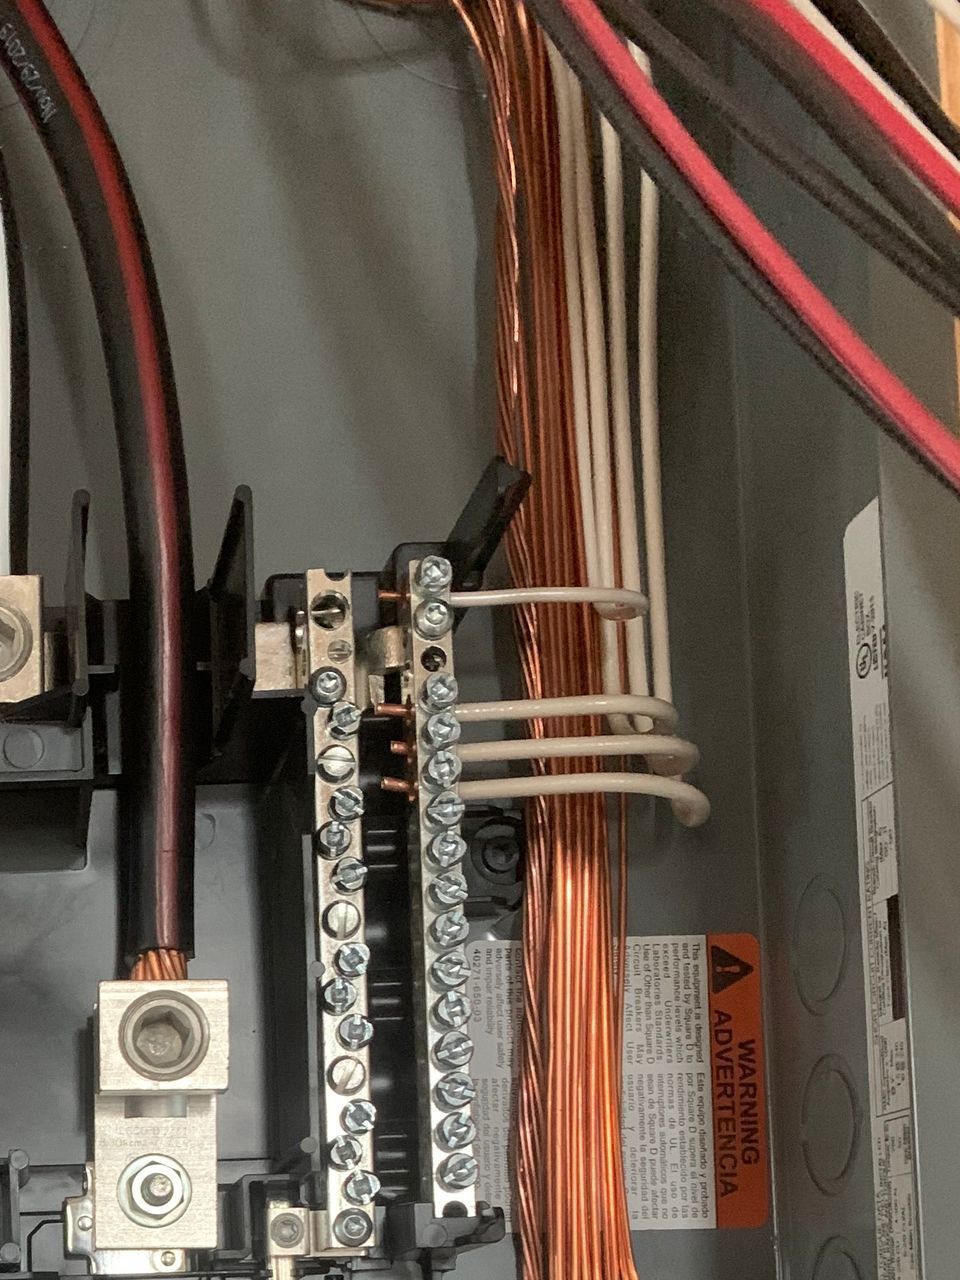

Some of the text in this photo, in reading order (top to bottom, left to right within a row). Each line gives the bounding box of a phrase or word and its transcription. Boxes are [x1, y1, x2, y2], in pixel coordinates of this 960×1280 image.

[504, 948, 512, 971] parts
[643, 944, 651, 960] Use
[485, 968, 494, 994] impair
[495, 948, 503, 991] adversely
[506, 975, 513, 984] of
[644, 964, 652, 972] of
[653, 944, 661, 1005] Laboratories
[672, 943, 681, 1001] performance
[683, 963, 691, 989] tested
[472, 949, 481, 1023] 40271-650-03
[644, 975, 653, 999] Other
[683, 994, 692, 1004] by
[485, 997, 495, 1035] reliability
[625, 1003, 633, 1032] Affect
[633, 944, 644, 1064] Circuit Breakers May
[645, 1001, 653, 1020] than
[663, 944, 673, 1064] exceed Underwriters
[692, 943, 704, 1063] This equipment is designed
[504, 1009, 513, 1044] product
[645, 1023, 653, 1054] Square
[683, 1008, 692, 1039] Square
[496, 1043, 505, 1069] safety
[626, 1042, 634, 1065] User
[686, 1055, 693, 1063] to
[667, 1073, 675, 1109] normas
[685, 1072, 693, 1087] por
[697, 1072, 705, 1092] Este
[636, 1074, 646, 1141] negativamente
[648, 1098, 656, 1109] de
[687, 1090, 696, 1122] Square
[697, 1096, 705, 1126] equipo
[713, 1009, 738, 1198] ADVERTENCIA
[737, 1039, 760, 1165] WARNING
[648, 1113, 657, 1144] Square
[669, 1117, 677, 1130] de
[688, 1126, 696, 1134] D
[483, 1140, 492, 1172] usuario
[640, 1144, 648, 1152] la
[656, 1073, 669, 1219] interruptores automáticos que no
[677, 1073, 690, 1219] rendimiento establecido por las
[688, 1137, 696, 1168] supera
[699, 1129, 707, 1169] diseñado
[492, 1127, 501, 1199] negativamente
[630, 1147, 639, 1196] deteriorar
[649, 1159, 658, 1186] puede
[670, 1163, 677, 1173] El
[690, 1171, 697, 1179] el
[639, 1157, 648, 1202] seguridad
[632, 1211, 639, 1219] la
[651, 1190, 659, 1219] afectar
[671, 1206, 678, 1219] de
[692, 1207, 699, 1218] de
[700, 1182, 709, 1218] probado
